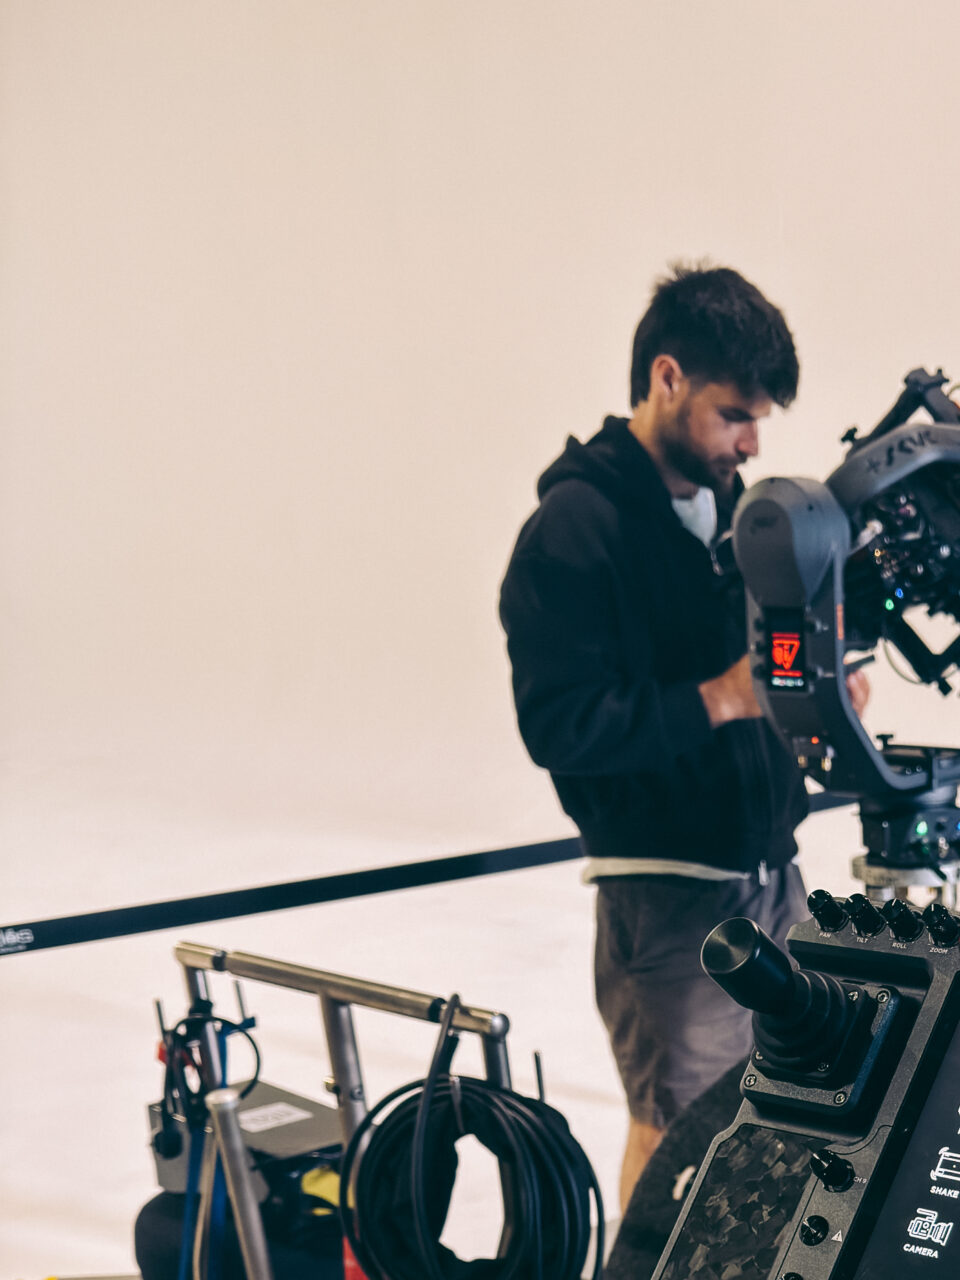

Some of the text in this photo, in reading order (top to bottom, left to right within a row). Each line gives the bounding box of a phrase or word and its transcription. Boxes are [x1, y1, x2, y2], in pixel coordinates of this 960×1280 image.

[929, 947, 948, 955] ZOOM
[929, 1185, 960, 1199] SHAKE
[903, 1243, 939, 1259] CAMERA
